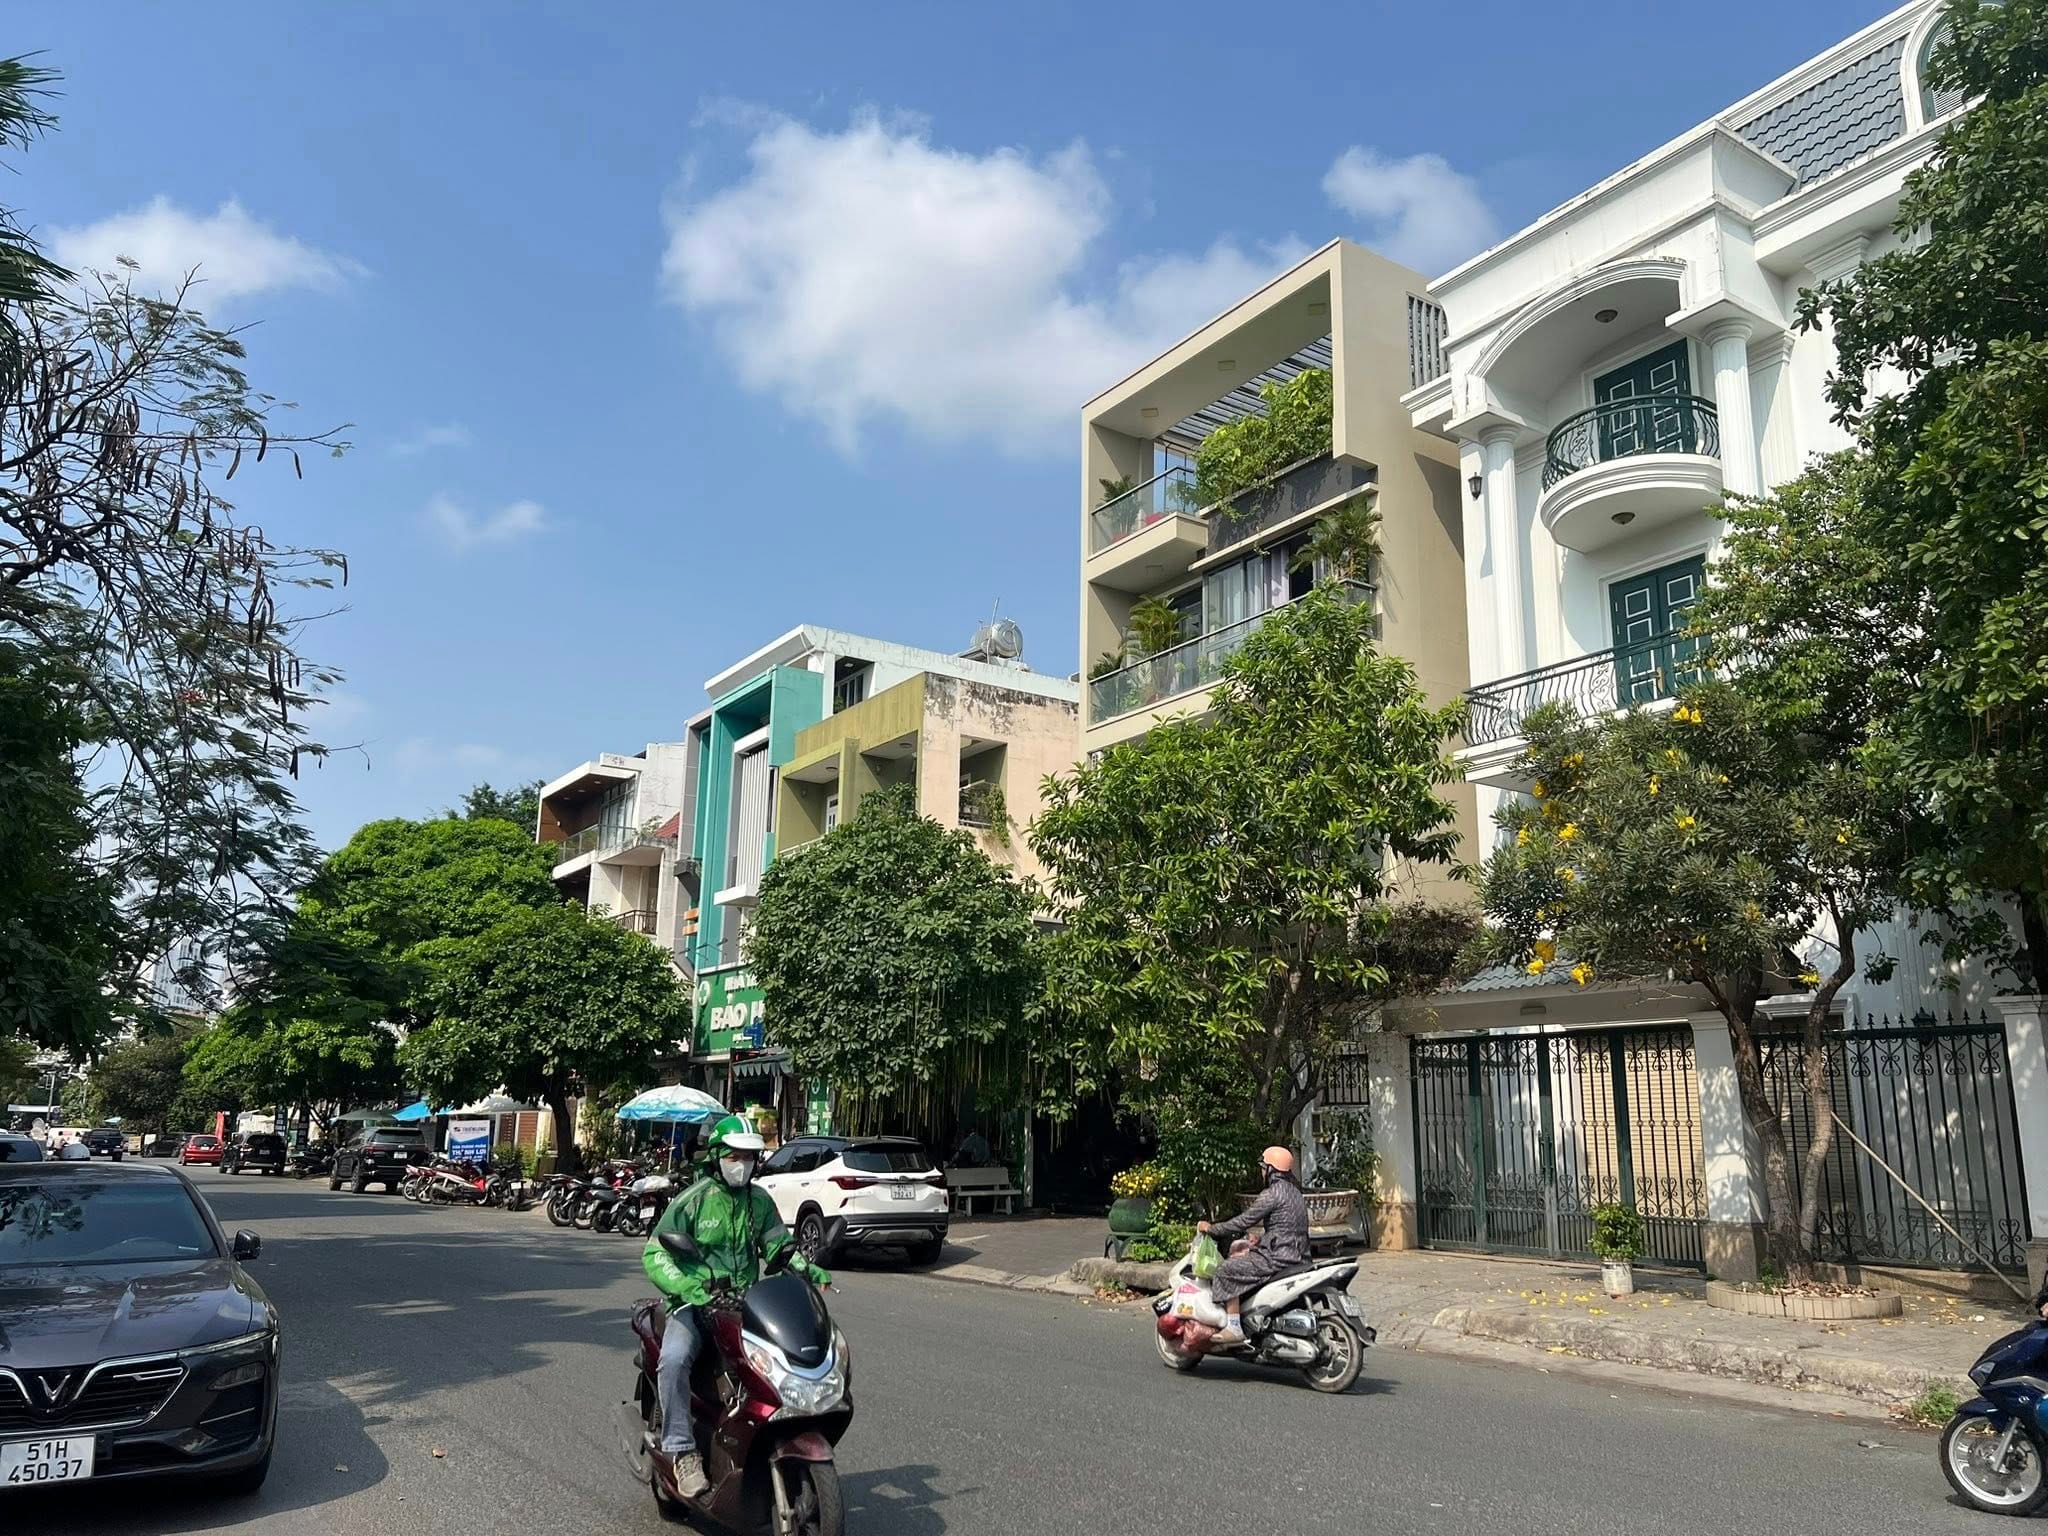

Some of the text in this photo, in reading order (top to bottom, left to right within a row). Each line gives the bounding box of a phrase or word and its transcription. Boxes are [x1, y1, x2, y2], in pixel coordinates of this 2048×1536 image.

[710, 993, 748, 1031] BẢO
[27, 1440, 68, 1461] 51H
[8, 1459, 84, 1484] 450.37
